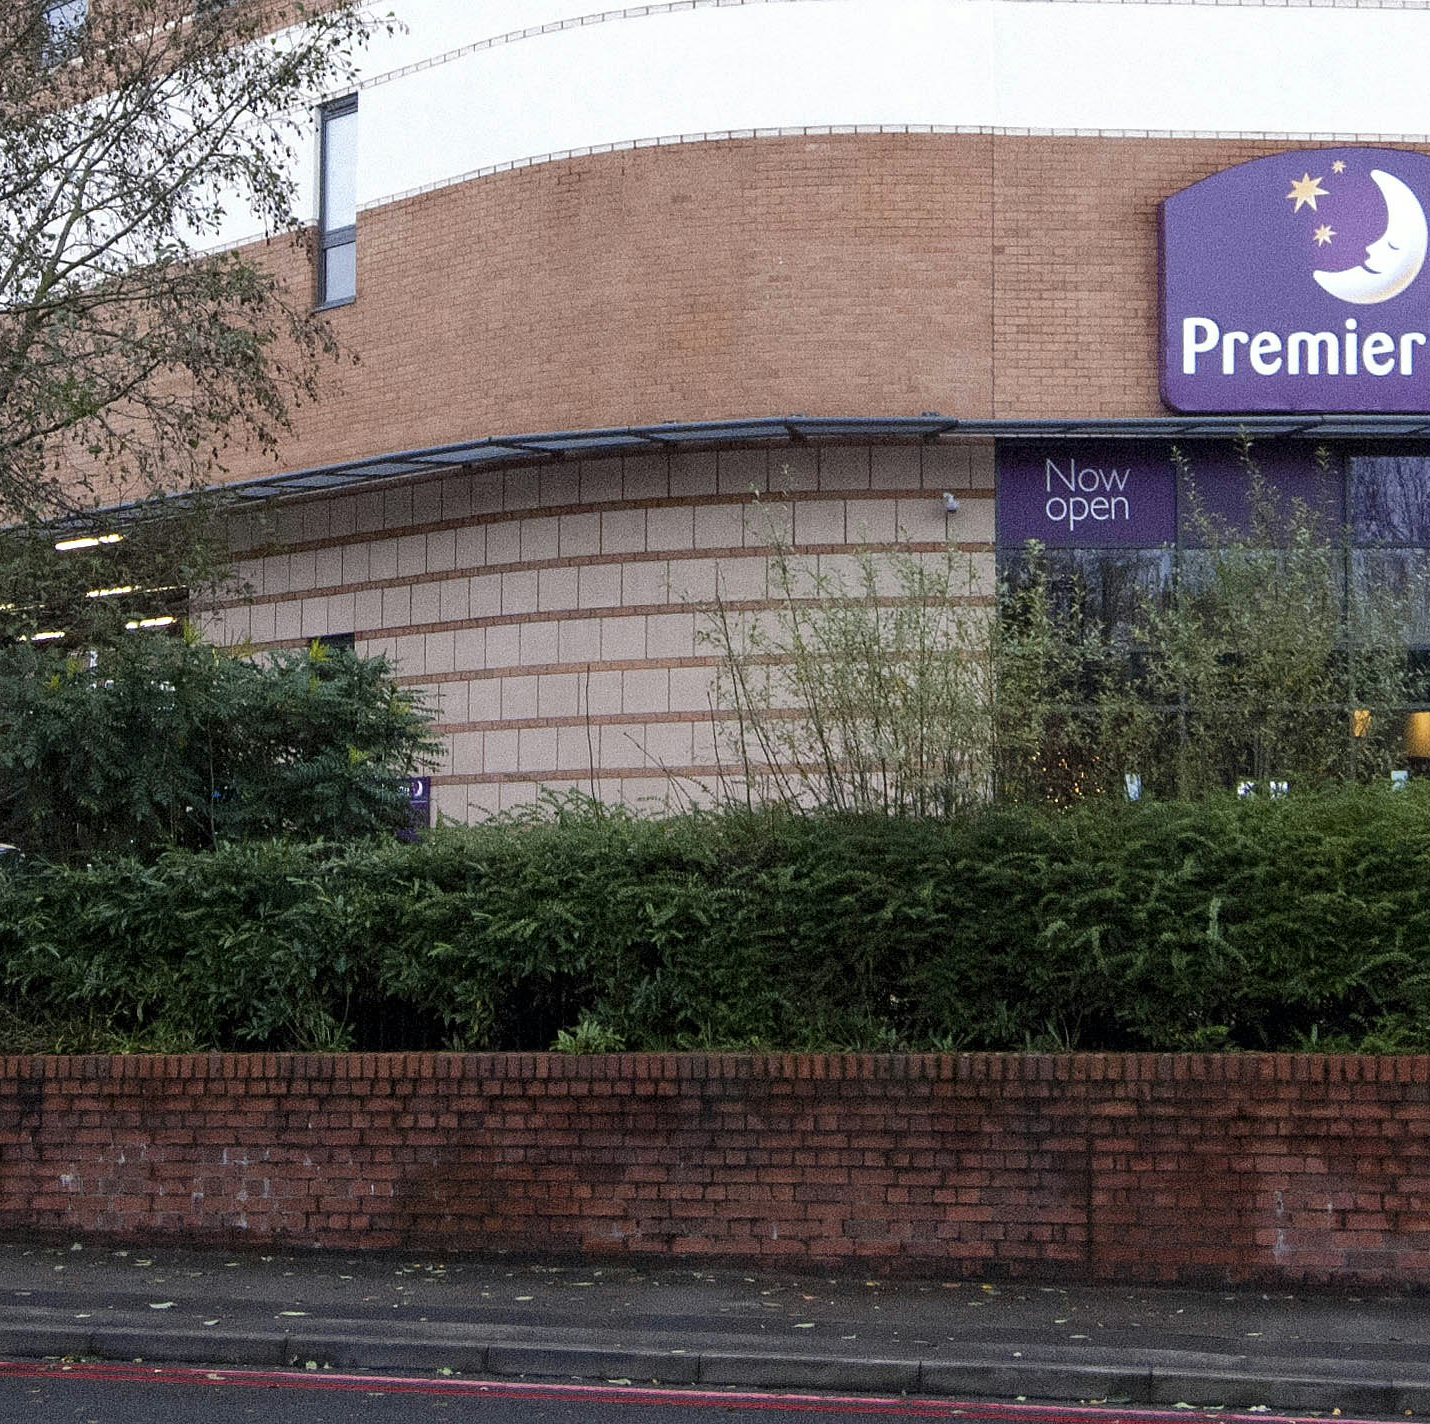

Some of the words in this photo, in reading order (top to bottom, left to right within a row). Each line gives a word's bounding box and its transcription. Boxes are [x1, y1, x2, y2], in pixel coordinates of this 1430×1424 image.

[1182, 317, 1427, 377] Premier
[1045, 457, 1131, 493] Now
[1045, 496, 1129, 532] open
